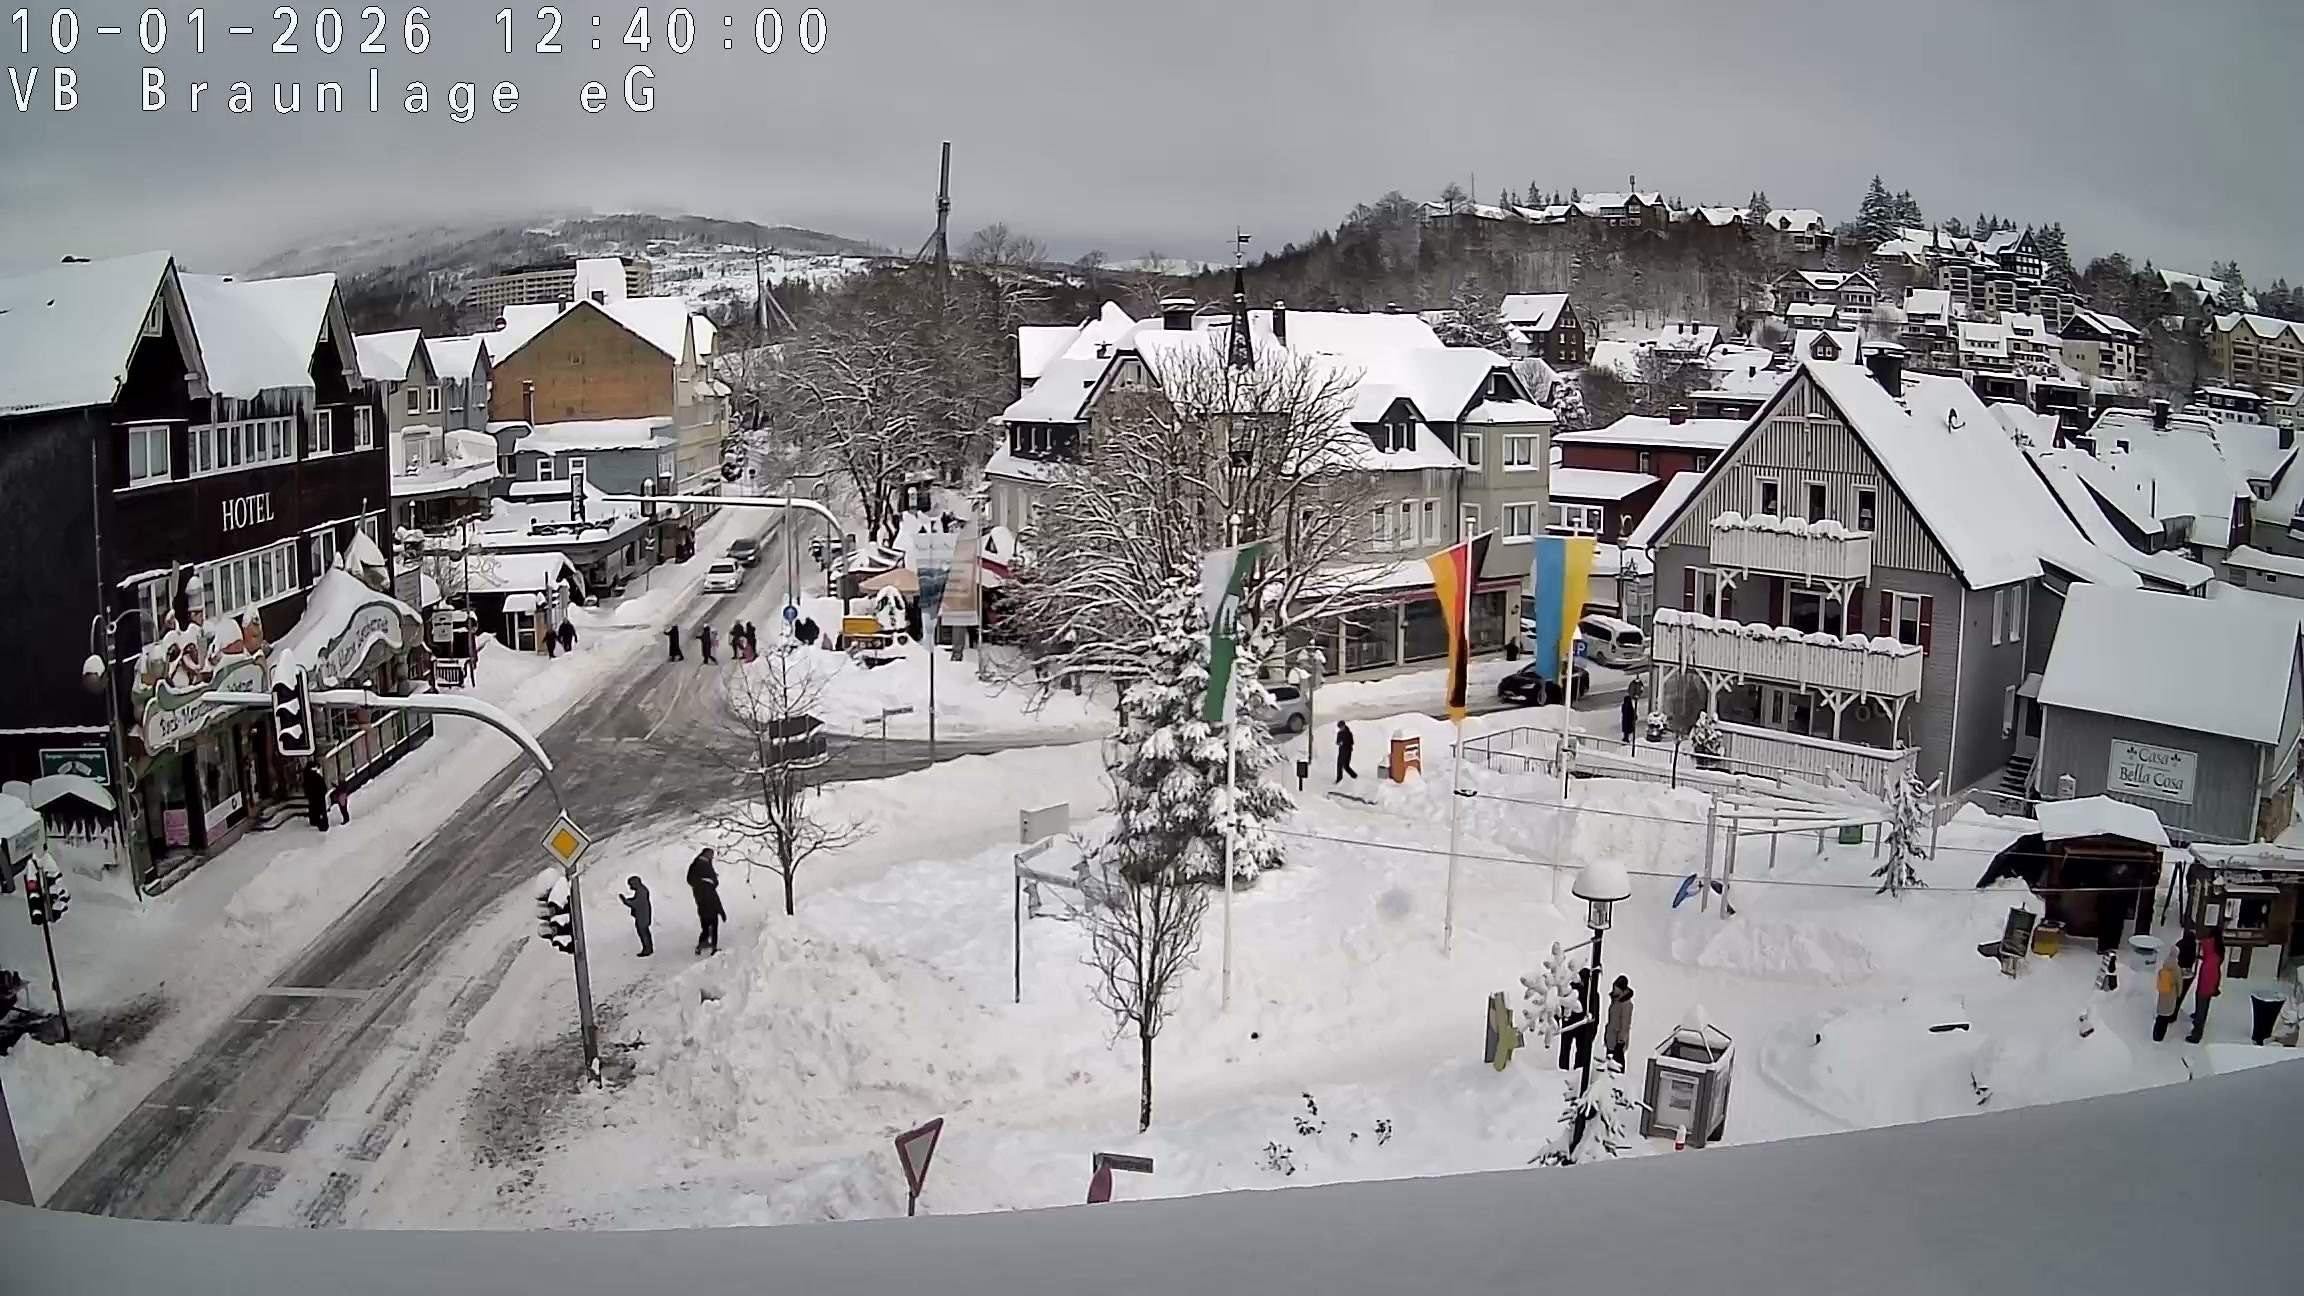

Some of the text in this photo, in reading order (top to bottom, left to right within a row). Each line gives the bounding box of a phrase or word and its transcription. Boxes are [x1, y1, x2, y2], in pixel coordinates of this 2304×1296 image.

[222, 492, 275, 532] HOTEL
[1577, 642, 1586, 655] P
[2139, 748, 2169, 765] Casa
[2120, 764, 2184, 790] Bella Cosa
